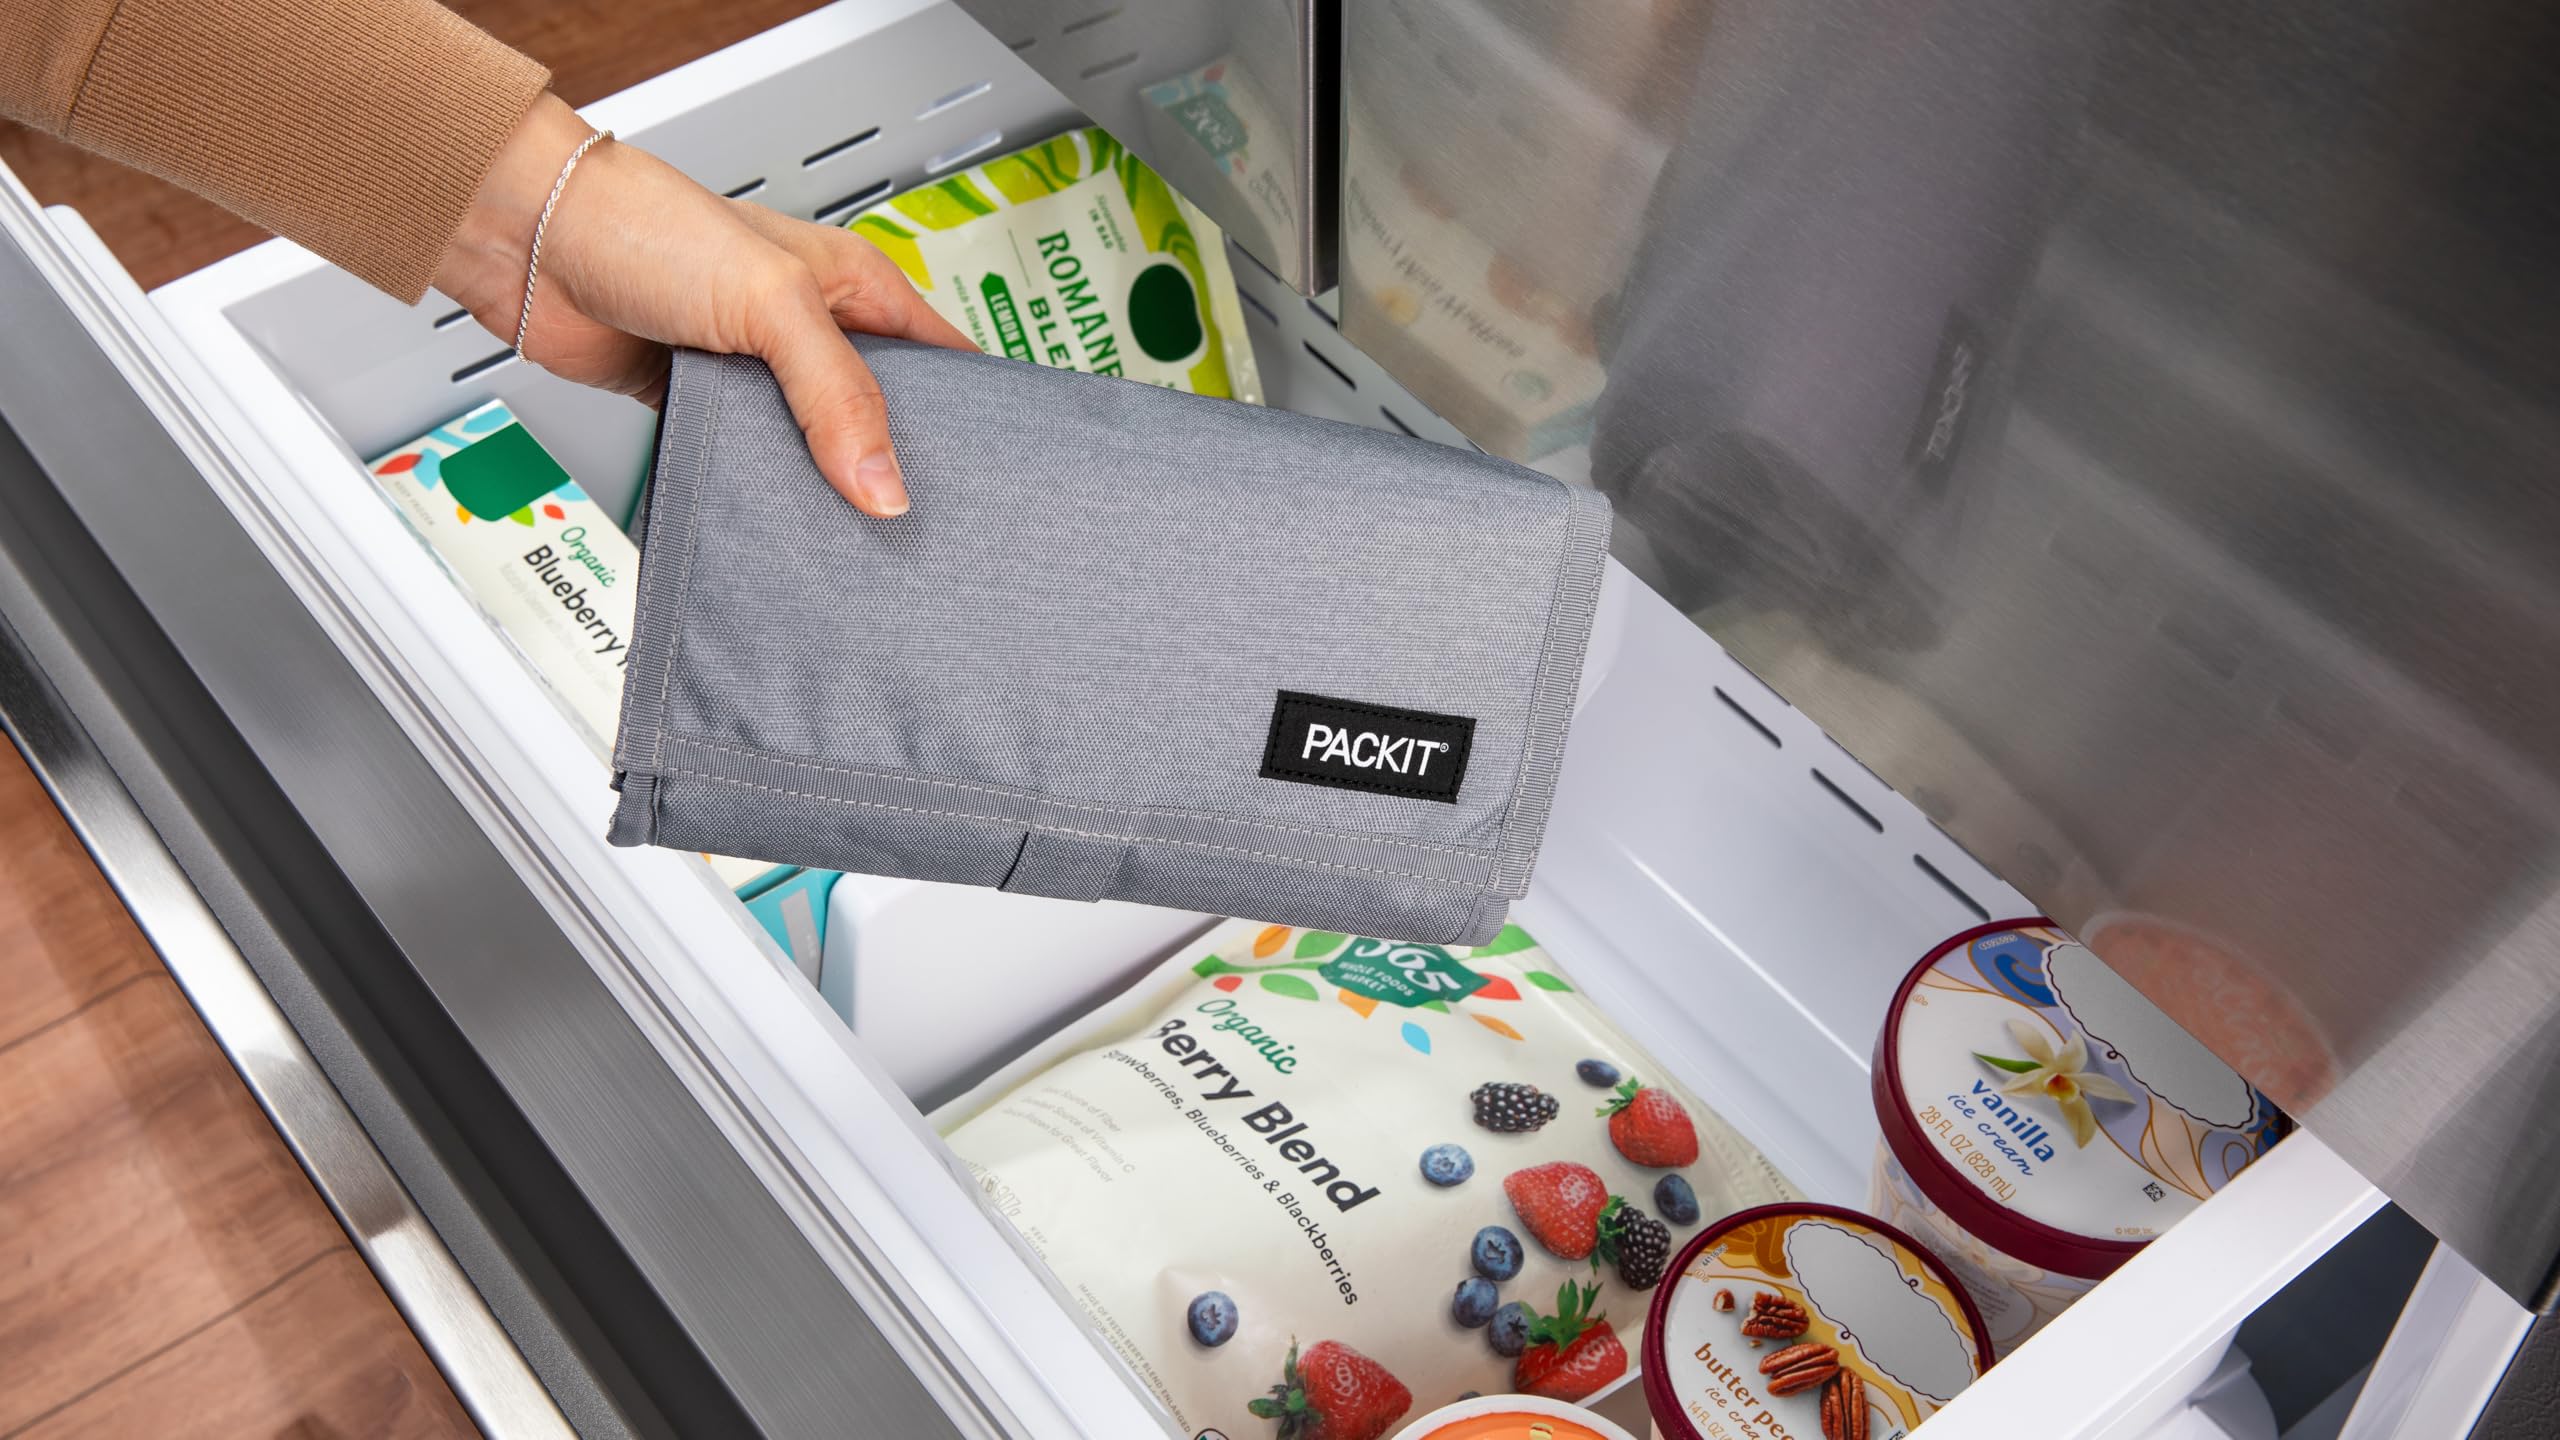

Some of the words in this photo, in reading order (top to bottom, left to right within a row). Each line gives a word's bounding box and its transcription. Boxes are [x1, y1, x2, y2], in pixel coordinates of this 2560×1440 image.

[965, 306, 990, 351] ROMAN
[990, 292, 1021, 343] LEMON
[1028, 297, 1076, 371] BLE
[1037, 230, 1124, 377] ROMANE
[561, 526, 616, 588] Organic
[523, 545, 625, 655] Blueberry
[1338, 961, 1375, 975] WHOLE
[1374, 969, 1416, 997] FOODS
[1341, 973, 1387, 992] MARKET
[1196, 999, 1297, 1074] Organic
[1097, 1112, 1121, 1132] Fiber
[1146, 1019, 1255, 1101] Berry
[1241, 1101, 1381, 1213] Blend
[1947, 1094, 1976, 1119] ice
[1977, 1122, 2034, 1176] cream
[1972, 1078, 2055, 1163] vanilla
[1061, 1135, 1088, 1157] Great
[1086, 1156, 1113, 1182] Flavor
[1091, 1131, 1126, 1165] Vitamin
[1122, 1163, 1136, 1173] C
[1919, 1105, 1941, 1125] 28
[1933, 1119, 1954, 1139] FL
[1949, 1133, 1973, 1155] OZ
[1963, 1150, 1997, 1179] (828
[1989, 1175, 2017, 1203] mL)
[1185, 1108, 1265, 1181] Blueberries
[1263, 1179, 1280, 1194] &
[1276, 1192, 1358, 1306] Blackberries
[1087, 1310, 1108, 1335] SHOW
[1078, 1283, 1100, 1307] IMAGE
[1097, 1305, 1109, 1317] OF
[1106, 1313, 1127, 1341] FRESH
[1123, 1338, 1145, 1362] BERRY
[1142, 1361, 1164, 1389] BLEND
[1161, 1388, 1191, 1434] ENLARGED
[1694, 1342, 1760, 1408] butter
[1752, 1410, 1795, 1440] pe
[1688, 1400, 1702, 1415] 14
[1697, 1410, 1711, 1427] FL
[1707, 1422, 1725, 1438] OZ
[1704, 1387, 1728, 1409] ice
[1728, 1411, 1761, 1440] crea
